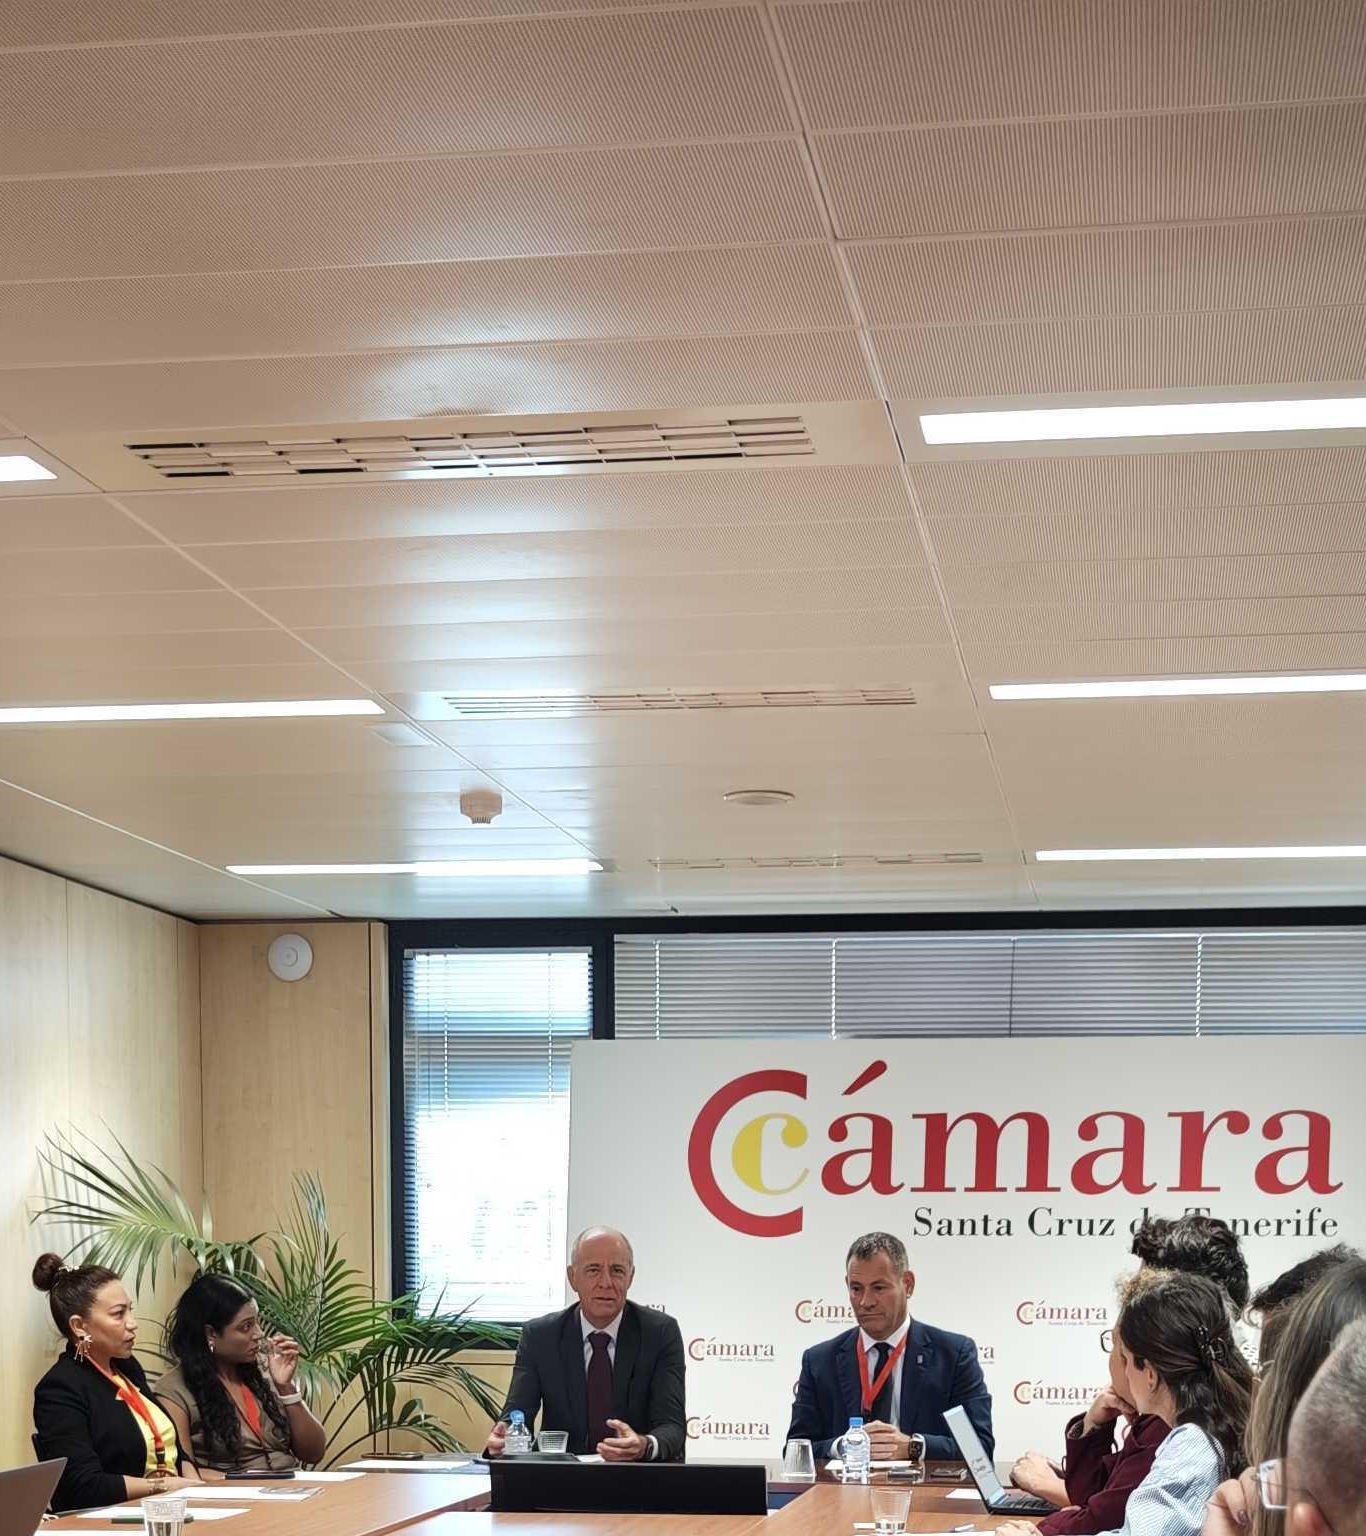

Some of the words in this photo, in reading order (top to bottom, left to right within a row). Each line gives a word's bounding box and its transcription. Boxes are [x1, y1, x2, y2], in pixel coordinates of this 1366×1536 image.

[912, 1206, 1013, 1237] Santa
[1027, 1206, 1115, 1237] Cruz
[1184, 1206, 1338, 1238] nerife
